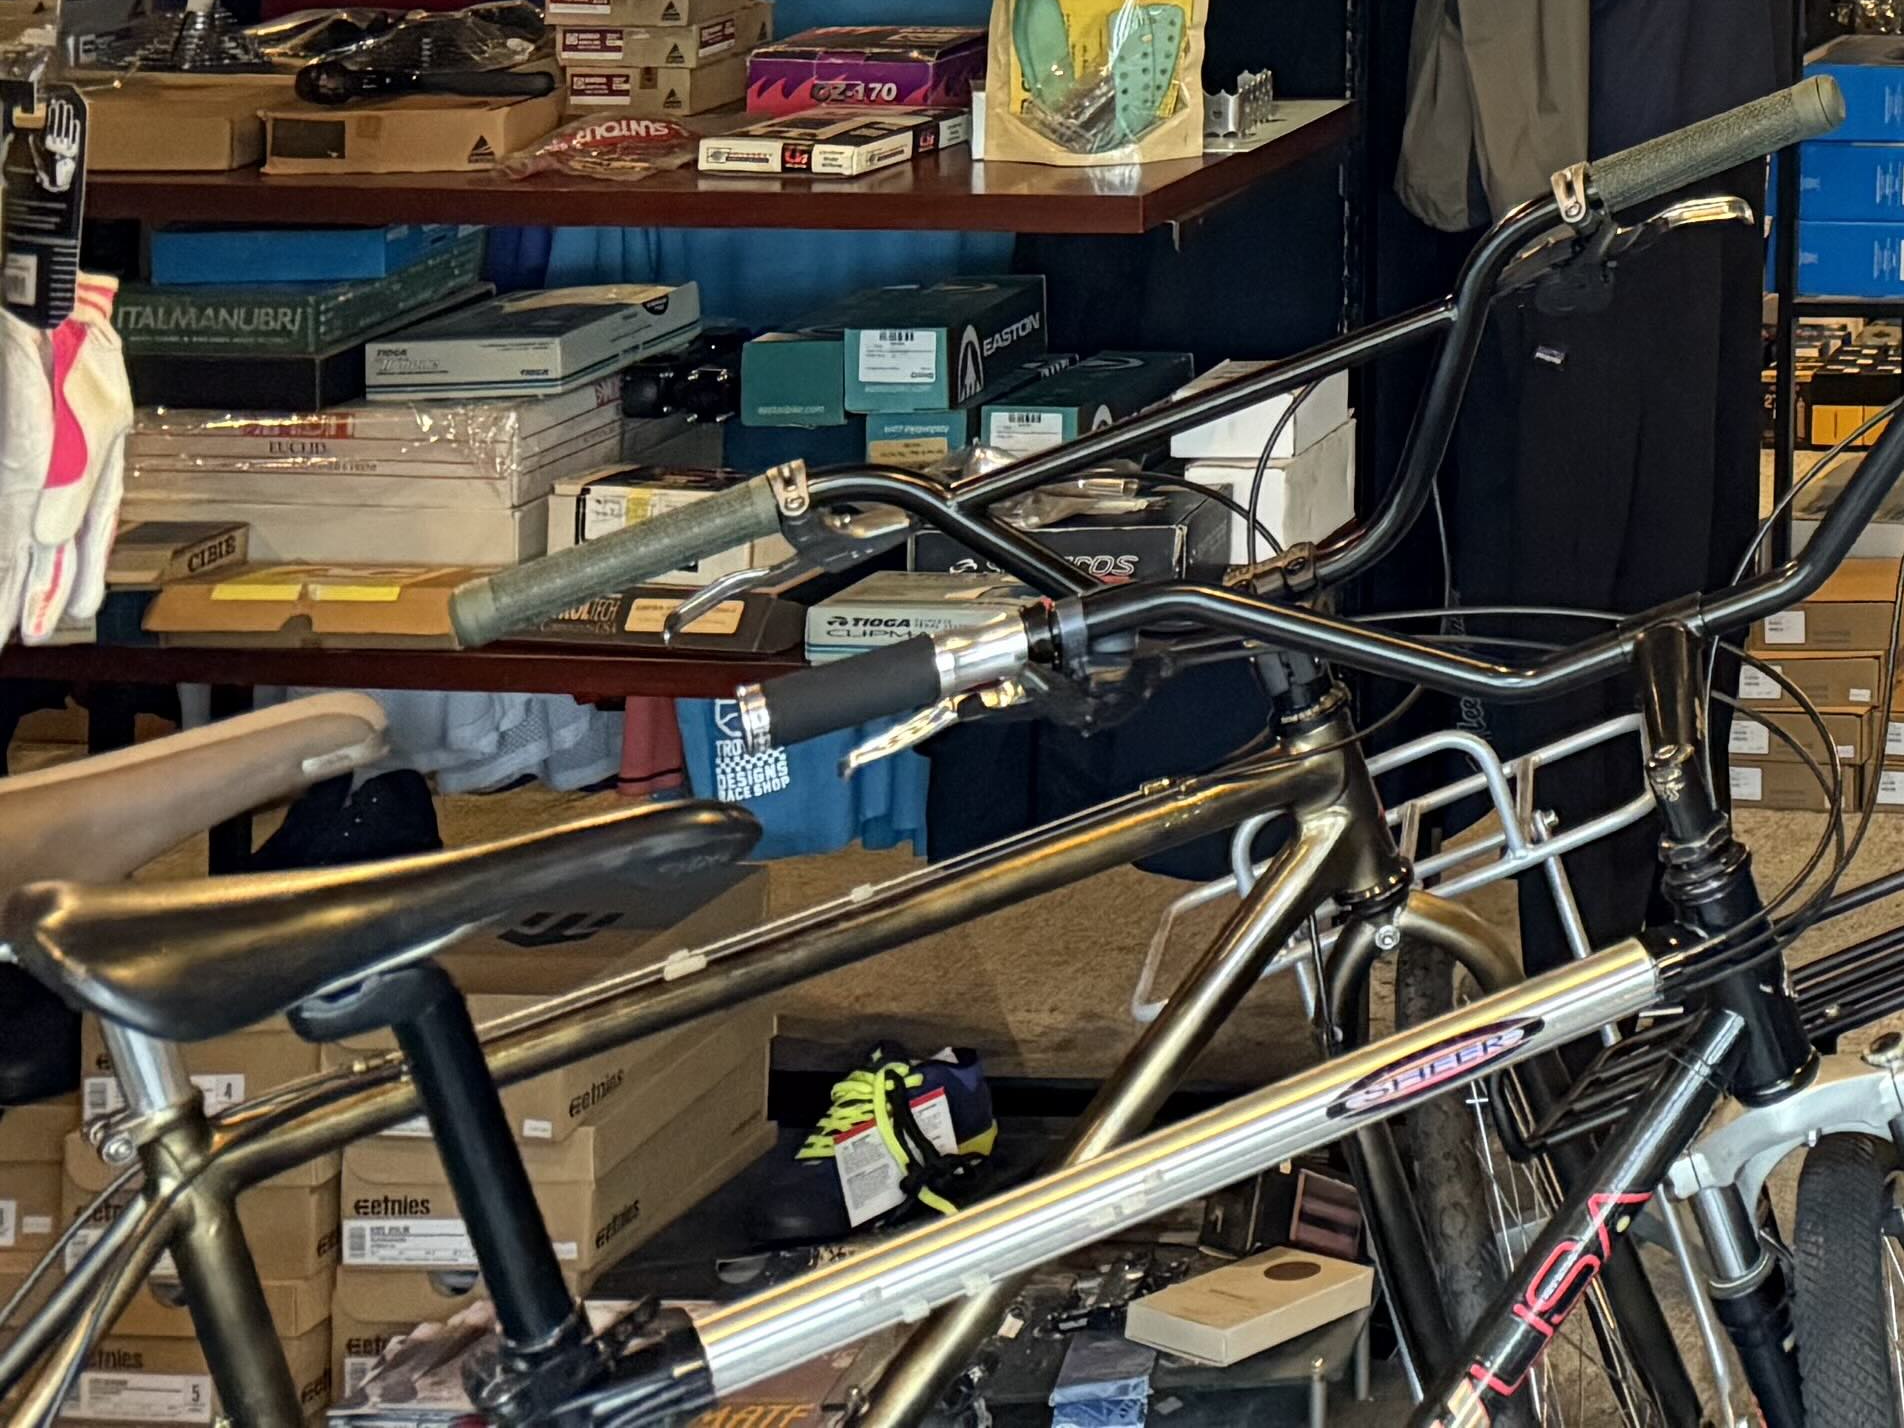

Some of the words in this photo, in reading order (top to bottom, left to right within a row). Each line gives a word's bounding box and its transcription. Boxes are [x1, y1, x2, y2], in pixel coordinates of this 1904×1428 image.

[117, 305, 303, 332] ITALMANUBRI
[983, 312, 1041, 356] EASTON
[268, 440, 328, 456] EUCLID
[852, 617, 912, 628] TIOGA
[715, 761, 789, 793] DESIGNS
[752, 773, 791, 798] SHOP
[579, 1070, 625, 1112] etnies
[367, 1196, 430, 1215] etnies
[191, 1385, 201, 1403] 5
